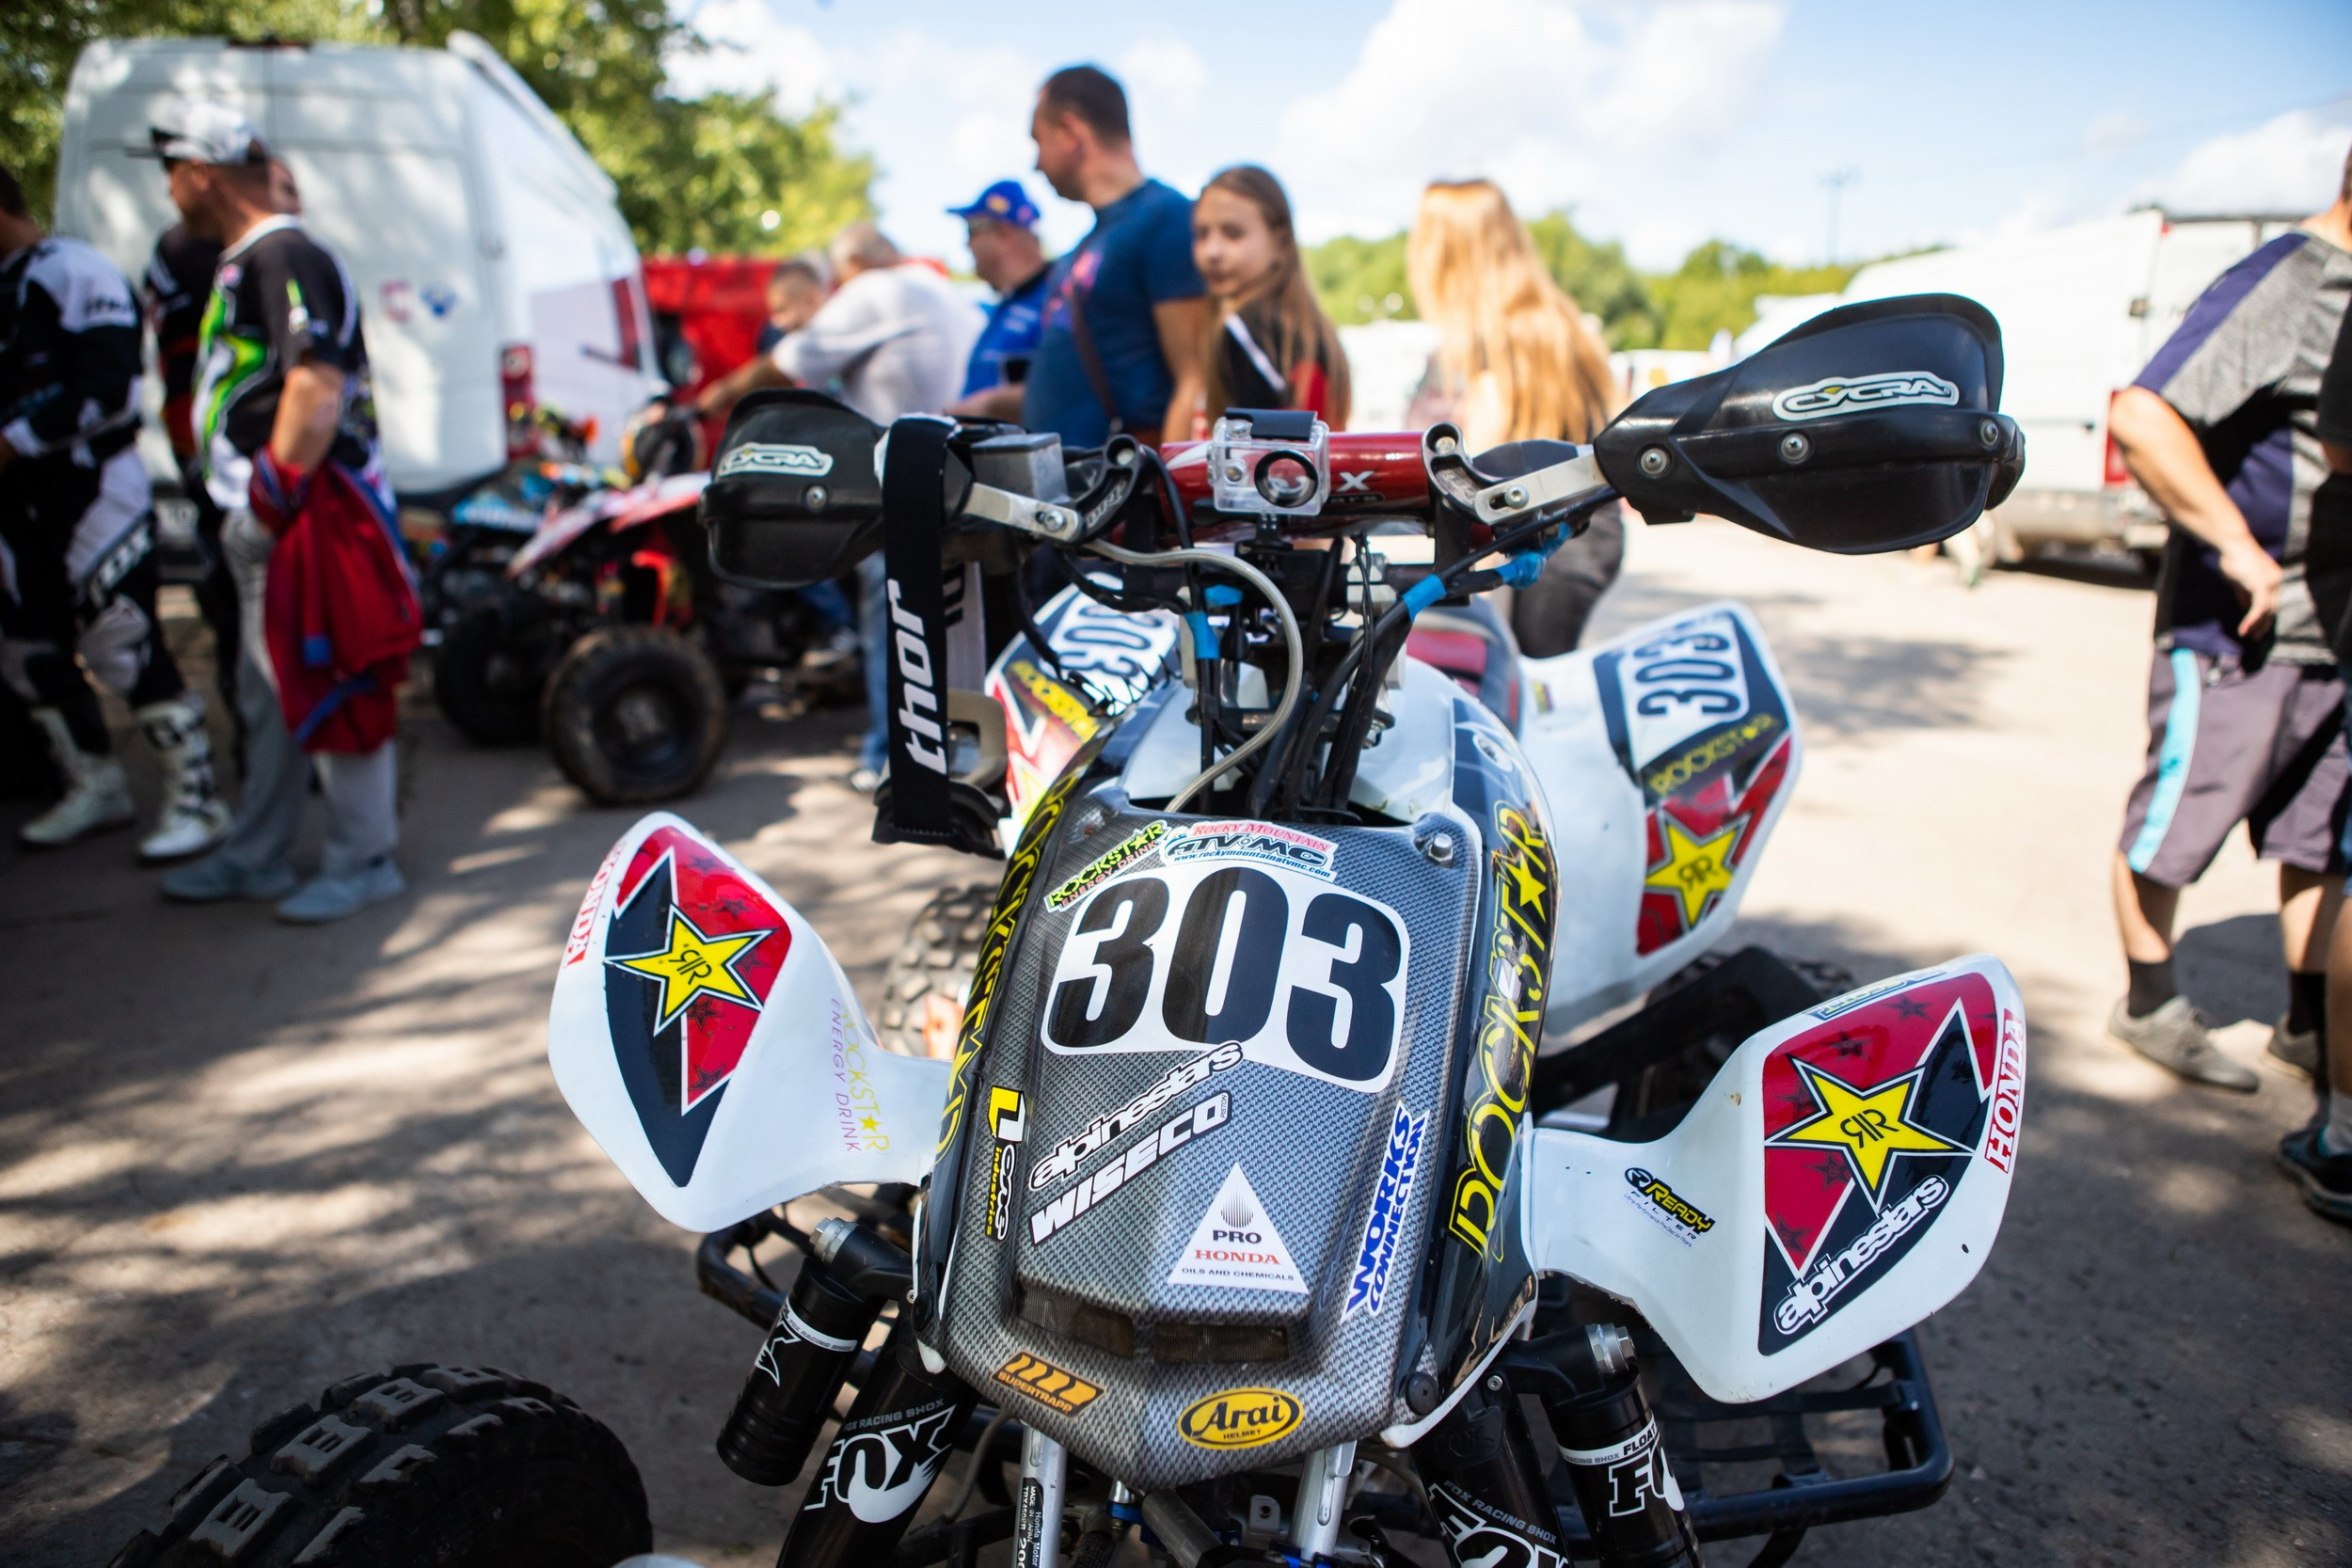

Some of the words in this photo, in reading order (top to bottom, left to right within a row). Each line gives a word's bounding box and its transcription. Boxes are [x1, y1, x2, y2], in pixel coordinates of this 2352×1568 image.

[1778, 375, 1953, 416] CYCRA
[886, 578, 947, 775] thor
[1634, 633, 1741, 716] 303
[1173, 848, 1331, 879] www.rockymountainatvmc.com
[1193, 823, 1243, 837] ROCKY
[1243, 822, 1329, 852] MOUNTAIN
[1061, 869, 1113, 907] ENERGY
[1117, 840, 1160, 870] DRINK
[1047, 865, 1402, 1083] 303
[831, 998, 847, 1084] ENERGY
[835, 1092, 862, 1152] DRINK
[1031, 1042, 1244, 1190] alpinestars
[1987, 1014, 2024, 1172] HONDA
[987, 1147, 1003, 1236] industries
[1030, 1092, 1228, 1244] WISECO
[1213, 1229, 1263, 1244] PRO
[1346, 1105, 1410, 1314] WORKS
[1369, 1116, 1427, 1312] CONNECTION
[1630, 1191, 1697, 1240] FILTER
[1645, 1182, 1711, 1230] READY
[1195, 1249, 1281, 1265] HONDA
[1232, 1271, 1294, 1281] CHEMICALS
[1774, 1175, 1948, 1334] alpinestars
[859, 1411, 902, 1430] RACING
[906, 1398, 945, 1418] SHOX
[998, 1371, 1073, 1413] SUPERTRAPP
[1200, 1395, 1286, 1434] Arai
[804, 1404, 957, 1523] FOX
[1222, 1429, 1263, 1440] HELMET
[1595, 1452, 1620, 1465] SHOX
[1623, 1422, 1658, 1457] FLOAT
[1443, 1479, 1472, 1501] FOX
[1474, 1497, 1526, 1531] RACING
[1527, 1524, 1557, 1545] SHOX
